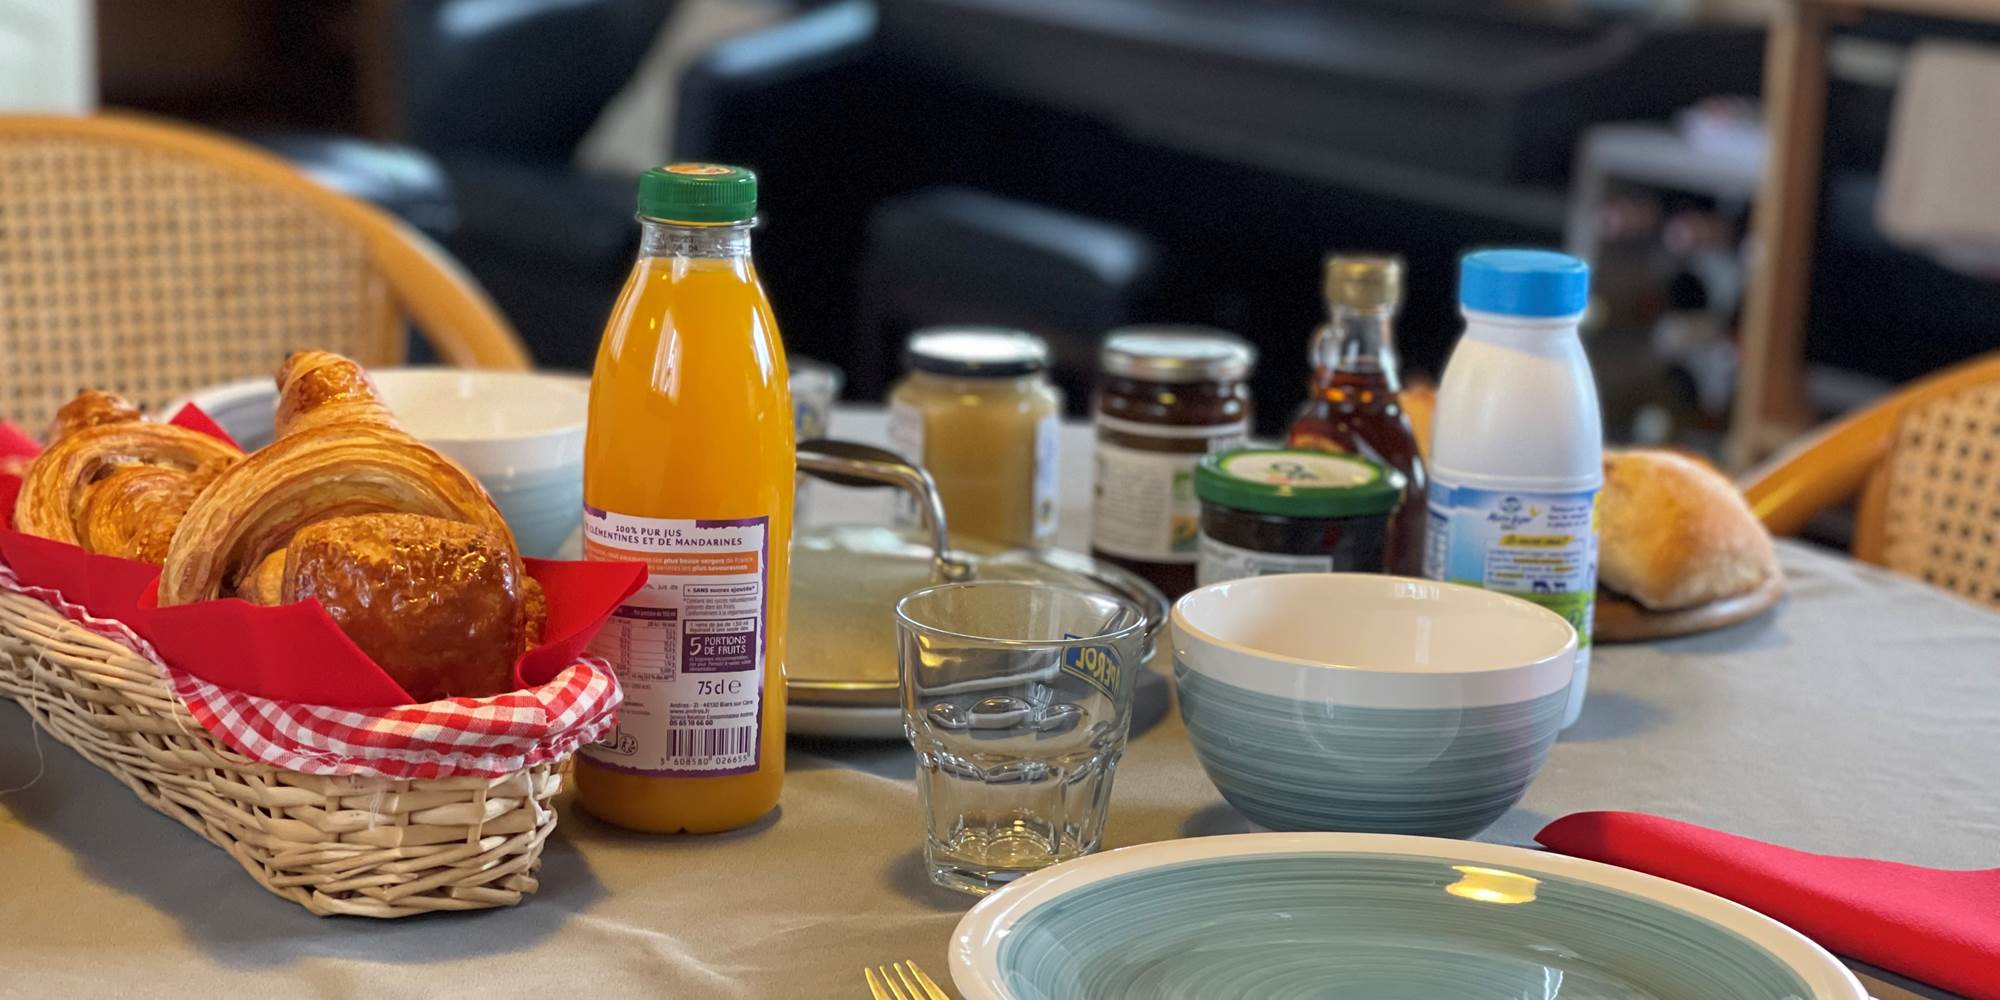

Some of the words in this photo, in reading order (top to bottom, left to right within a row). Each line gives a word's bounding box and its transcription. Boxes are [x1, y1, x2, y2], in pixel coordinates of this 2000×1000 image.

[615, 525, 637, 534] 100%
[640, 528, 660, 536] PUR
[664, 528, 682, 538] JUS
[642, 537, 654, 545] ET
[658, 538, 672, 546] DE
[675, 538, 742, 546] MANDARINES
[689, 636, 702, 656] 5
[704, 635, 746, 646] PORTIONS
[704, 646, 716, 656] DE
[718, 645, 746, 655] FRUITS
[697, 681, 712, 696] 75
[714, 680, 724, 695] cl
